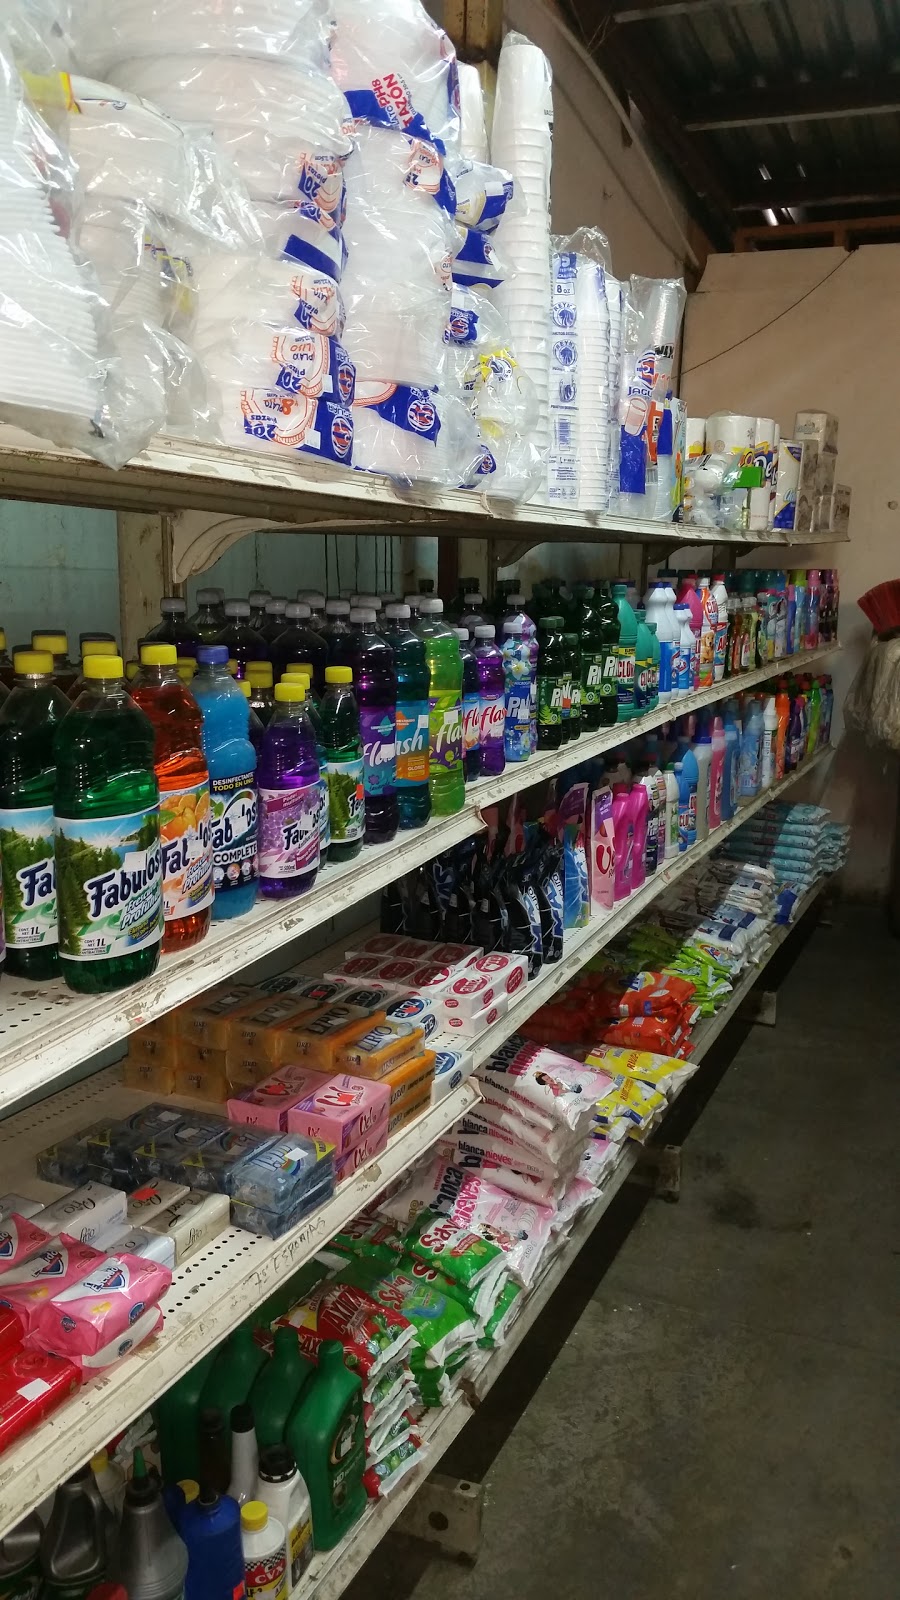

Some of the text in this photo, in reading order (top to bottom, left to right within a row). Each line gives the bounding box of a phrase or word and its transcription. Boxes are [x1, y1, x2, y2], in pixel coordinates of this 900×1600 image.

[305, 175, 320, 198] 20
[283, 371, 303, 392] 20
[213, 782, 235, 792] TODO
[235, 781, 244, 789] EN
[355, 1025, 393, 1052] LIRIO
[458, 1141, 486, 1156] blanca
[254, 1566, 285, 1584] CVX
